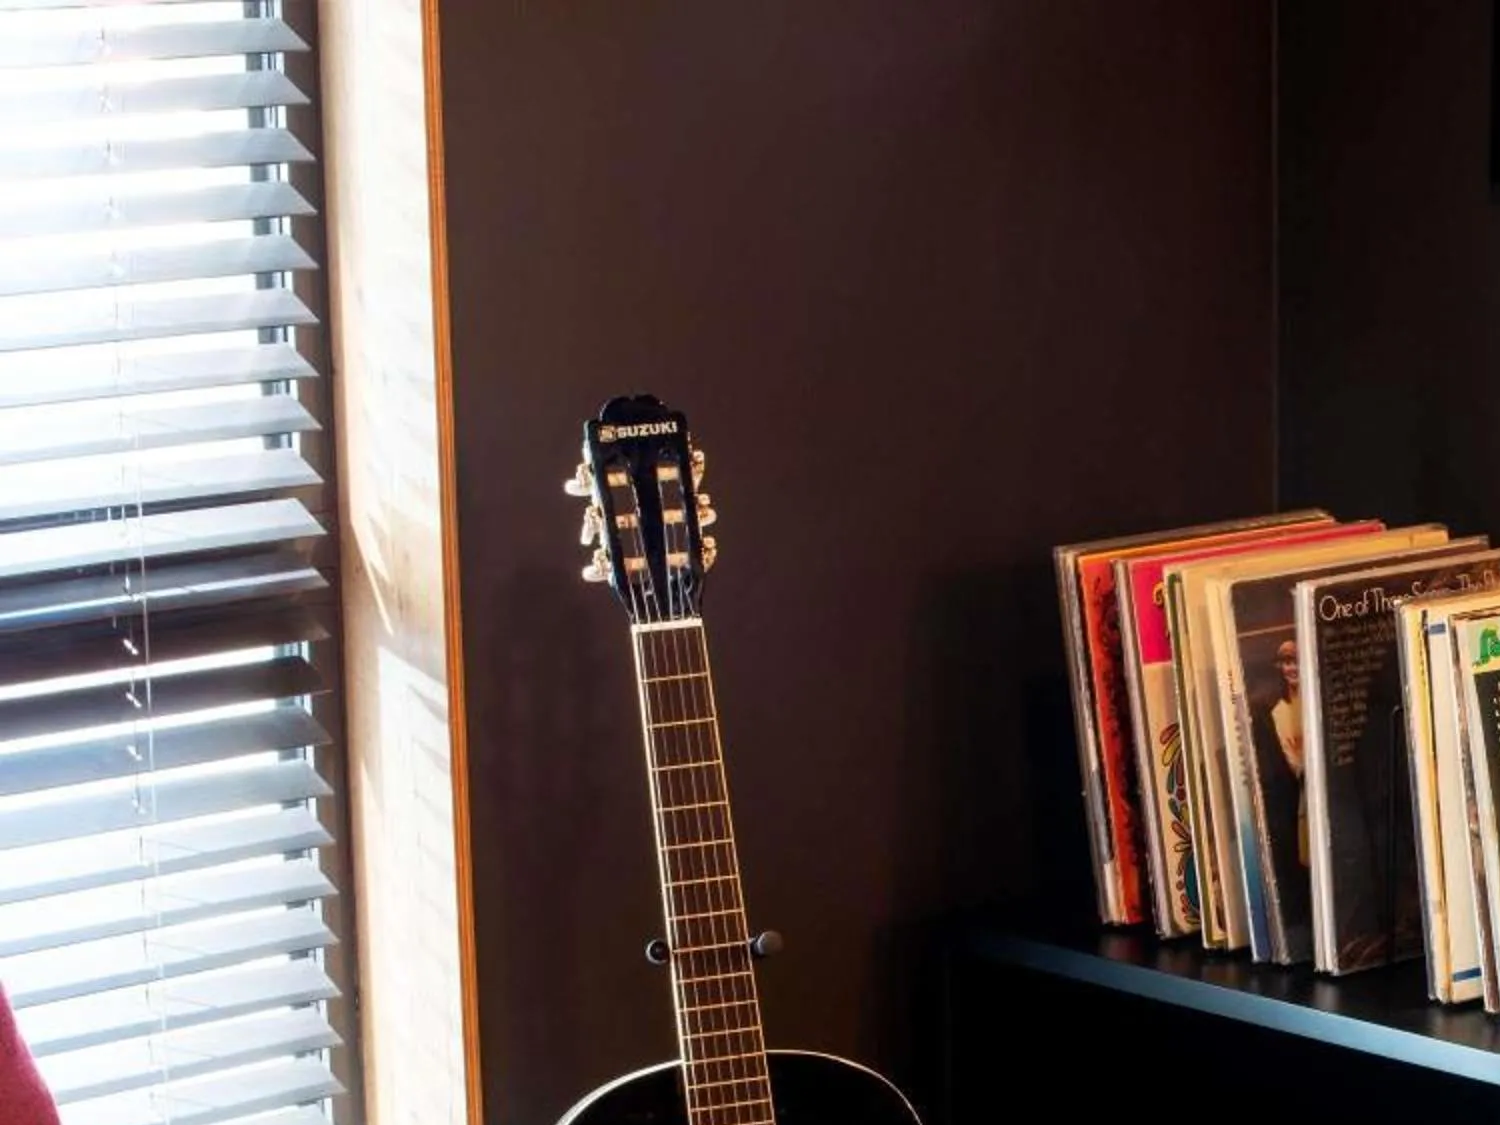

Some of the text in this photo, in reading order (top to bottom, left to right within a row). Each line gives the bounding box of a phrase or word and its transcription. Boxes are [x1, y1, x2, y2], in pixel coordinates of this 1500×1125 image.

[617, 421, 678, 439] SUZUKI
[1319, 595, 1353, 622] One
[1355, 588, 1370, 615] of
